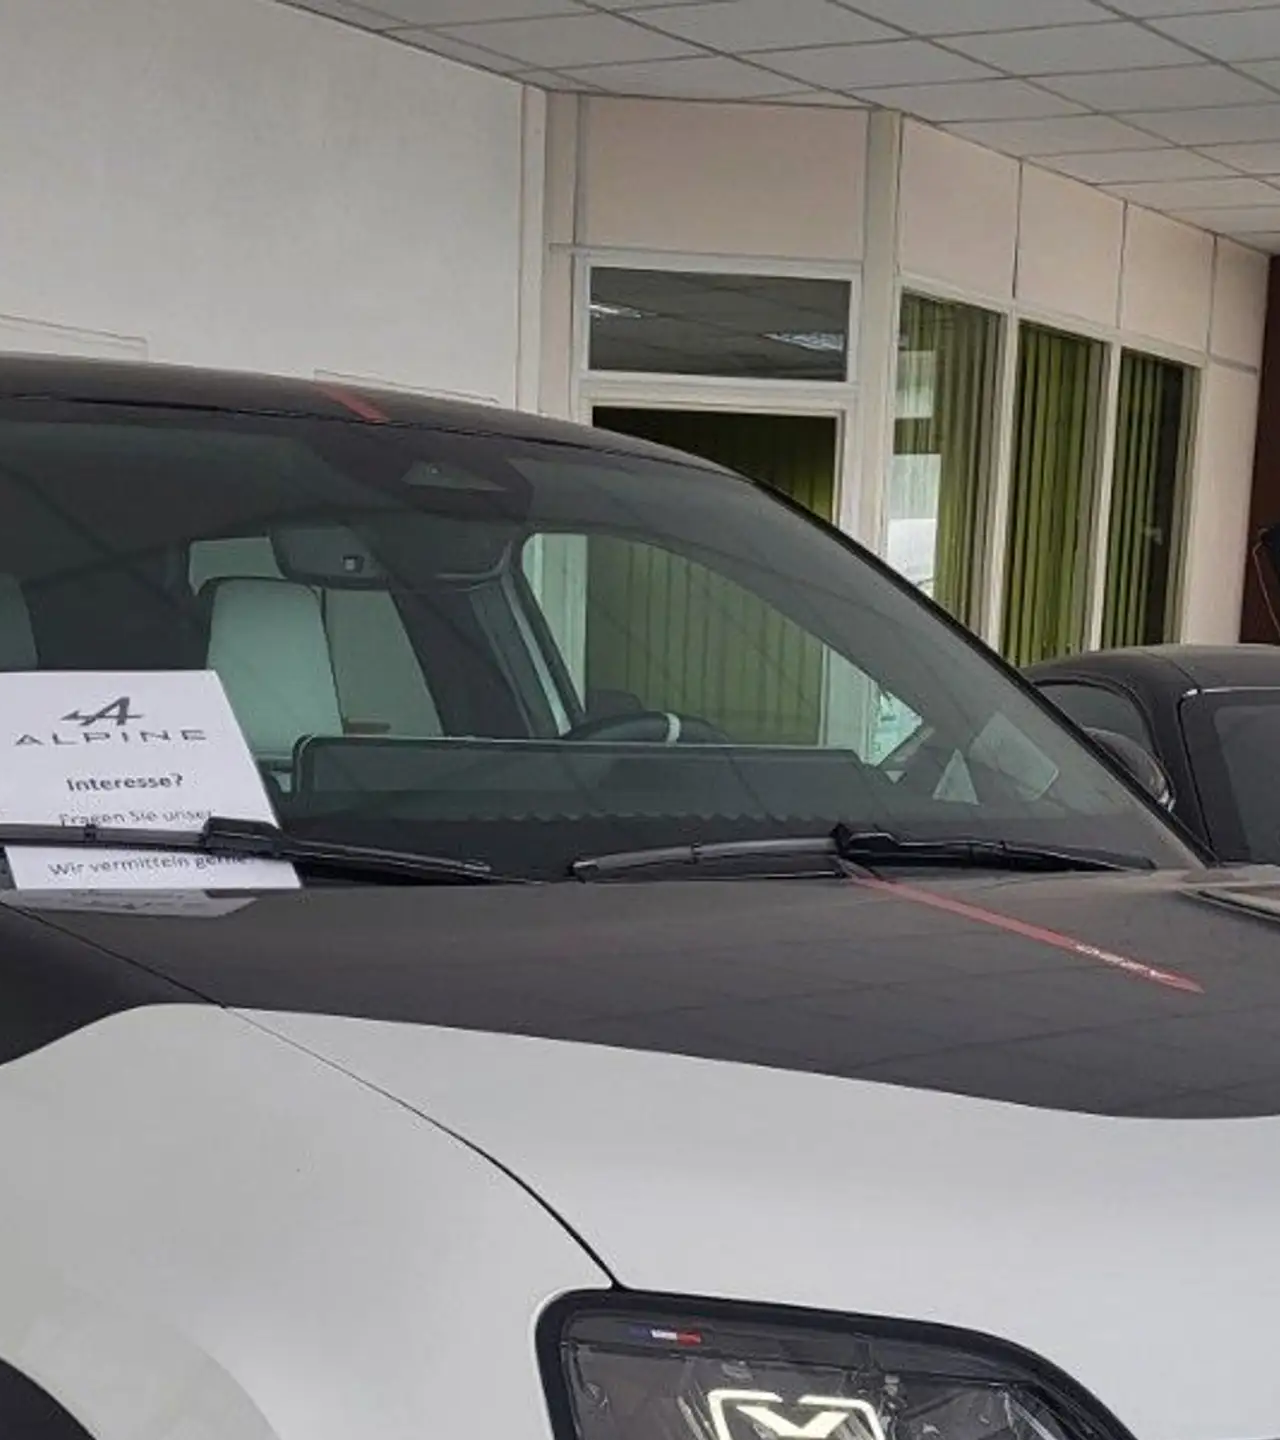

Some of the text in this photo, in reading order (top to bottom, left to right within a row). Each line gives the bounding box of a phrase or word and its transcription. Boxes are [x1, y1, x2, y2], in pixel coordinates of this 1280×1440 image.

[15, 729, 208, 747] ALPINE
[66, 772, 184, 792] Interesse?
[128, 809, 158, 822] Sie
[47, 861, 84, 875] Wir
[89, 854, 190, 872] vermitteln
